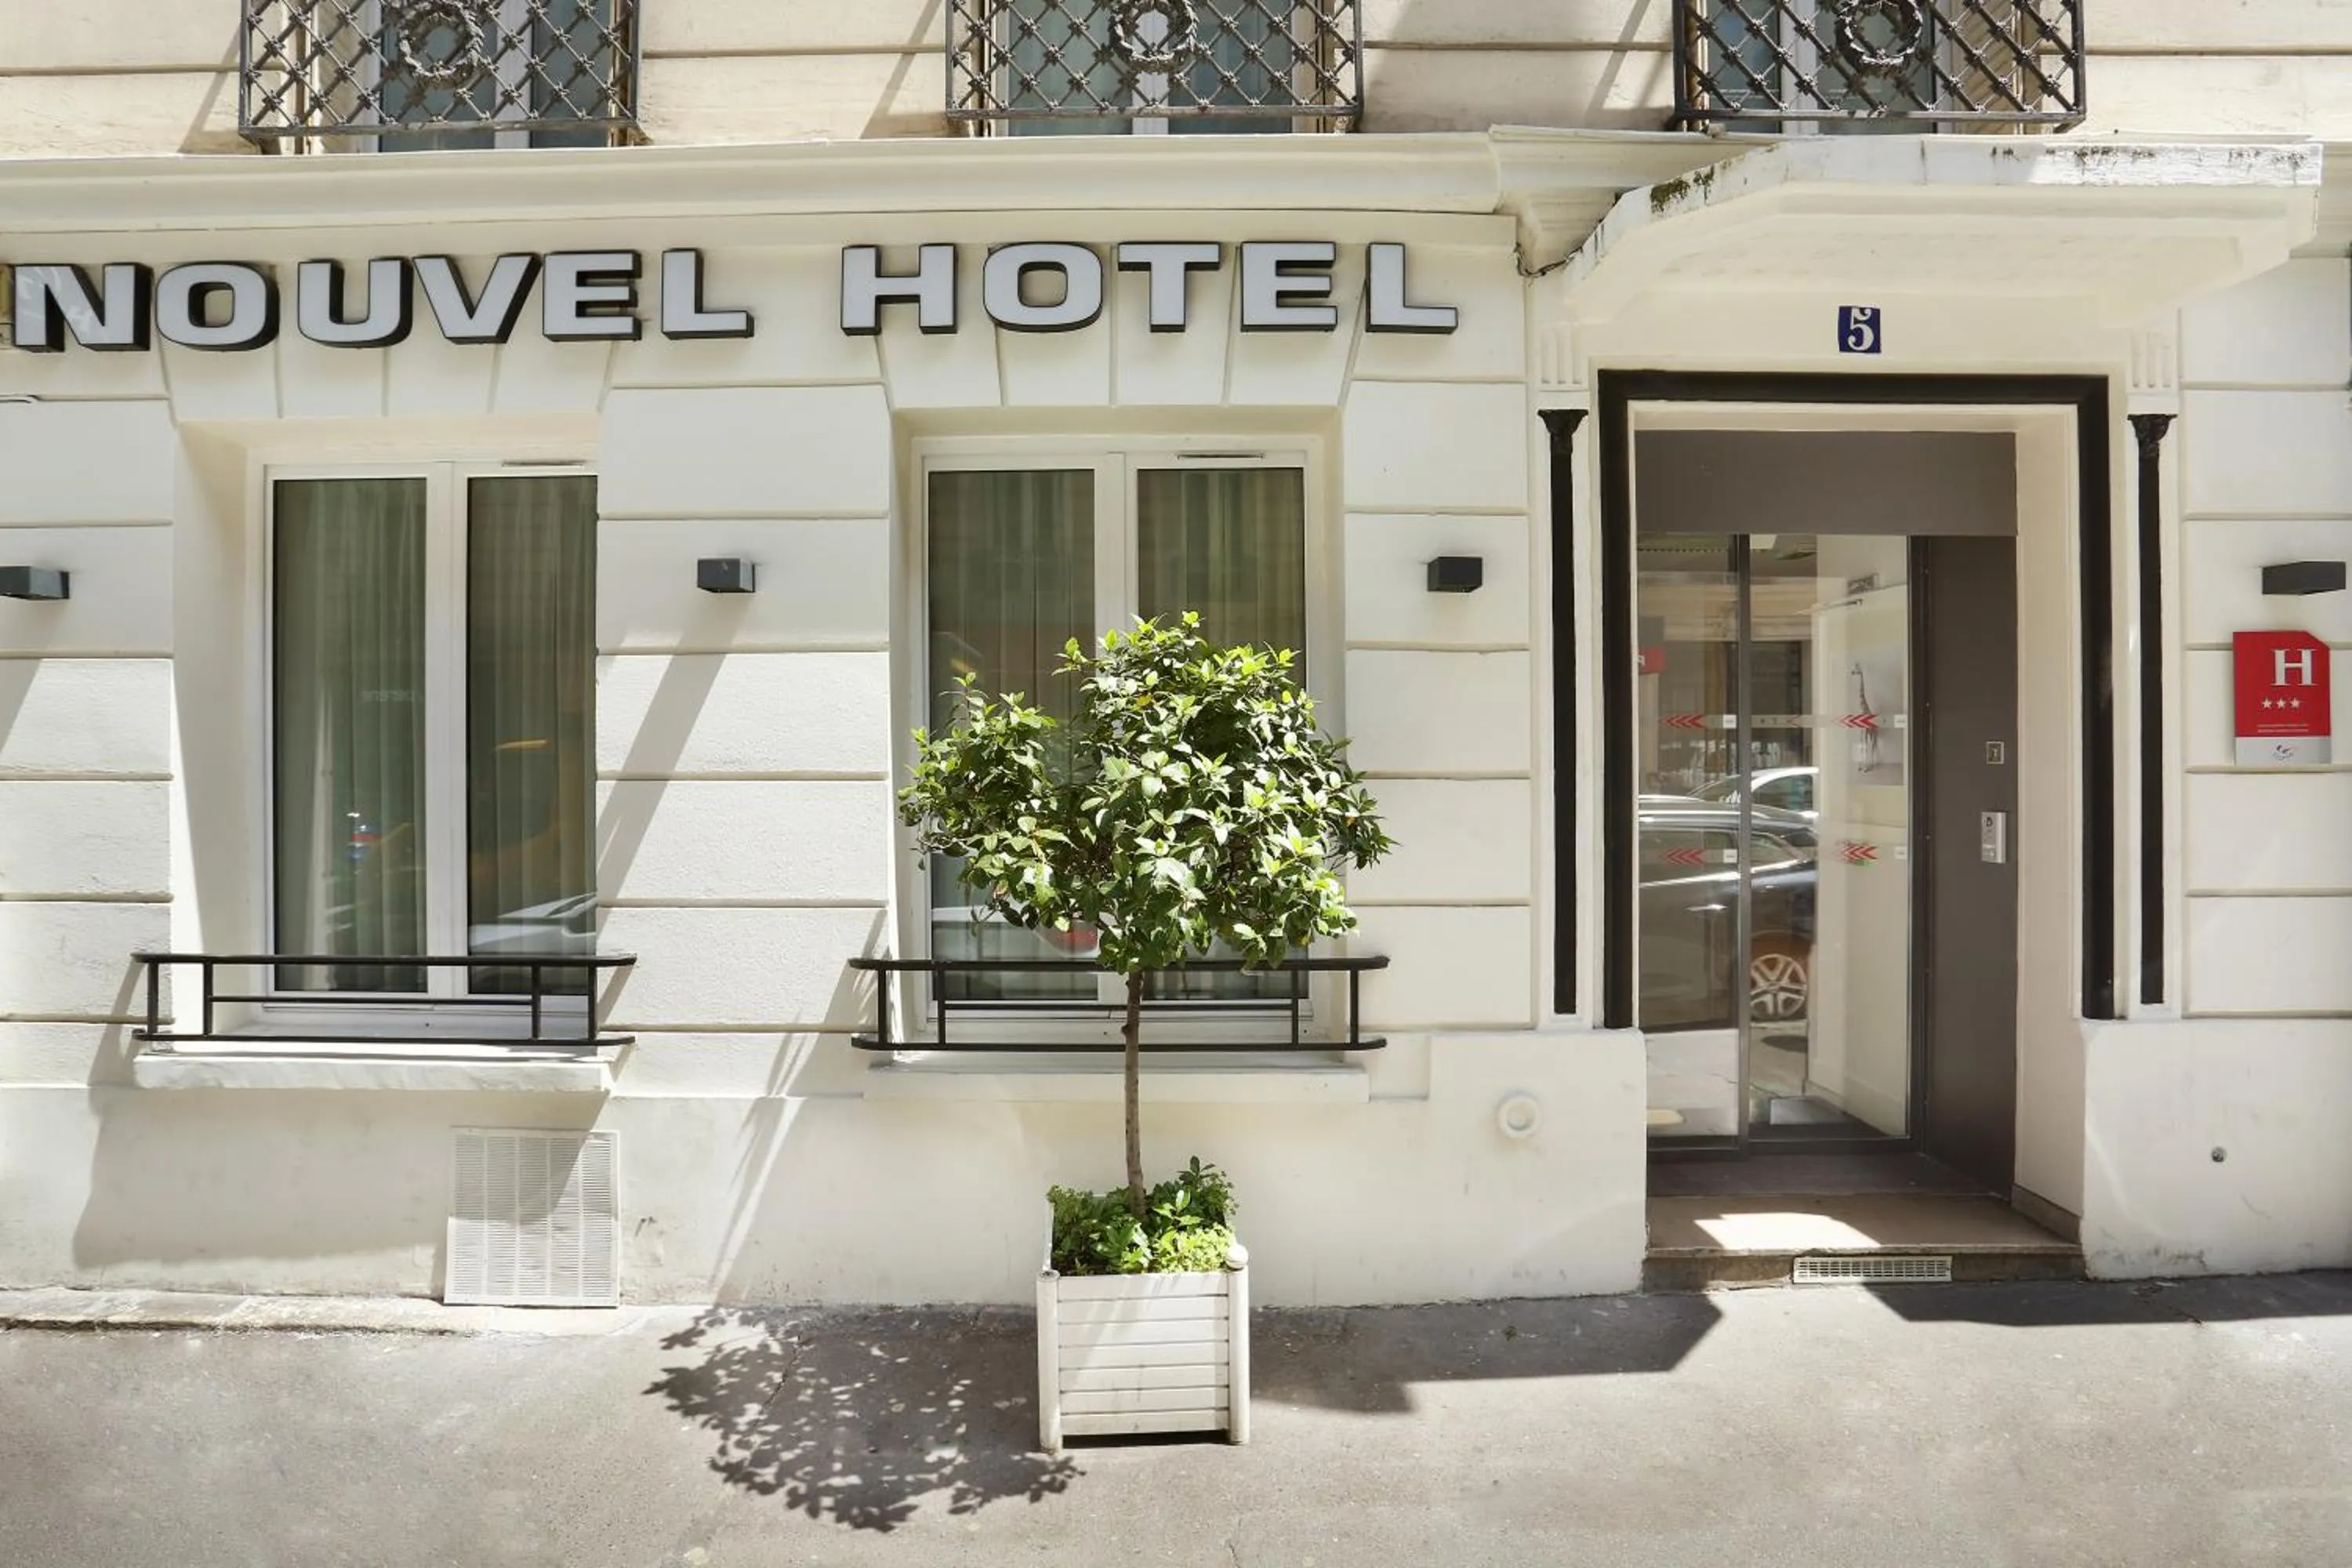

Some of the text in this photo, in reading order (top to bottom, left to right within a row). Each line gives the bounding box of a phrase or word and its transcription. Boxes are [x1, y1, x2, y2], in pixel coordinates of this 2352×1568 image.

[13, 241, 1459, 352] NOUVEL HOTEL
[1848, 307, 1875, 351] 5
[2270, 648, 2318, 686] H
